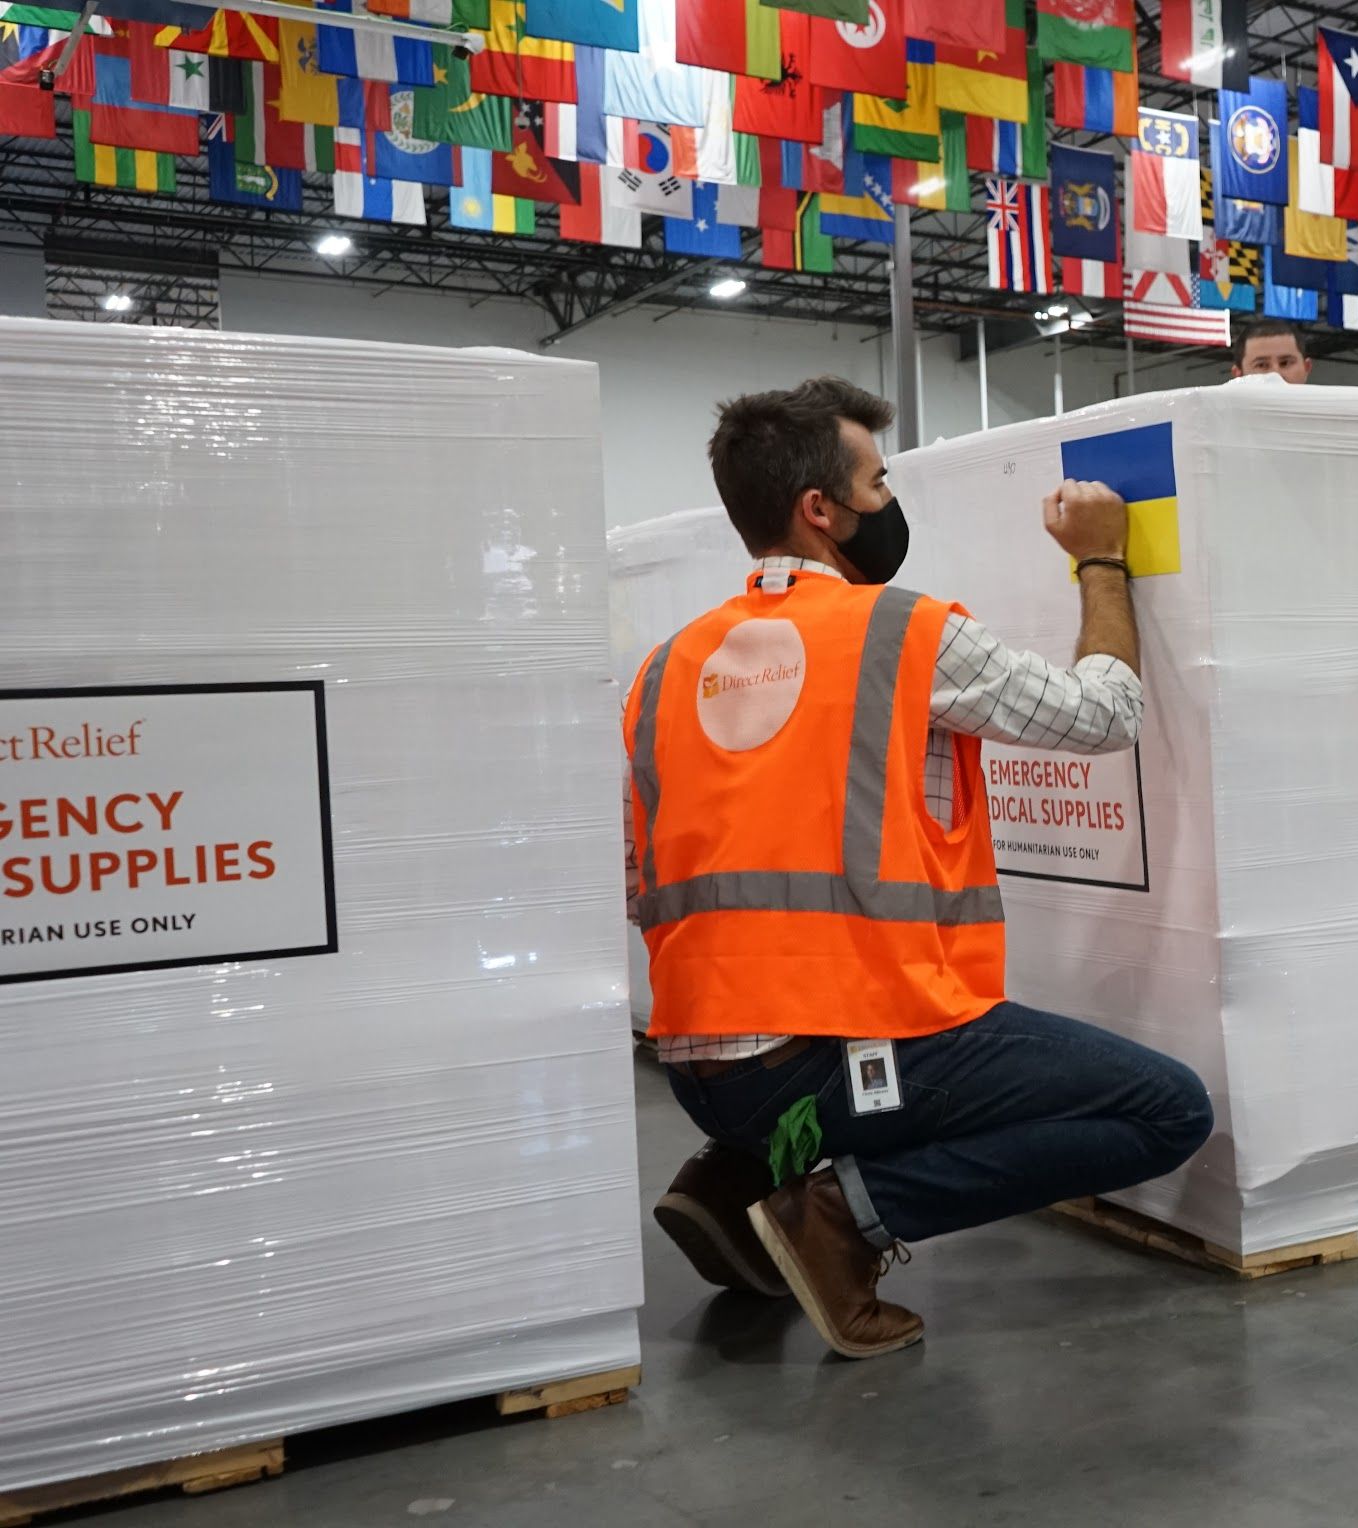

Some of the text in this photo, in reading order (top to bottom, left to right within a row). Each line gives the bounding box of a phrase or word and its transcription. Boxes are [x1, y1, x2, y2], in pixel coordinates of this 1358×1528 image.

[722, 660, 801, 692] Direct Relief
[27, 719, 143, 761] Relief
[990, 759, 1091, 790] EMERGENCY
[987, 795, 1125, 831] DICAL SUPPLIES
[993, 839, 1100, 861] FOR HUMANITARIAN USE ONLY
[2, 840, 276, 898] SUPPLIES
[1, 913, 196, 946] RIAN USE ONLY
